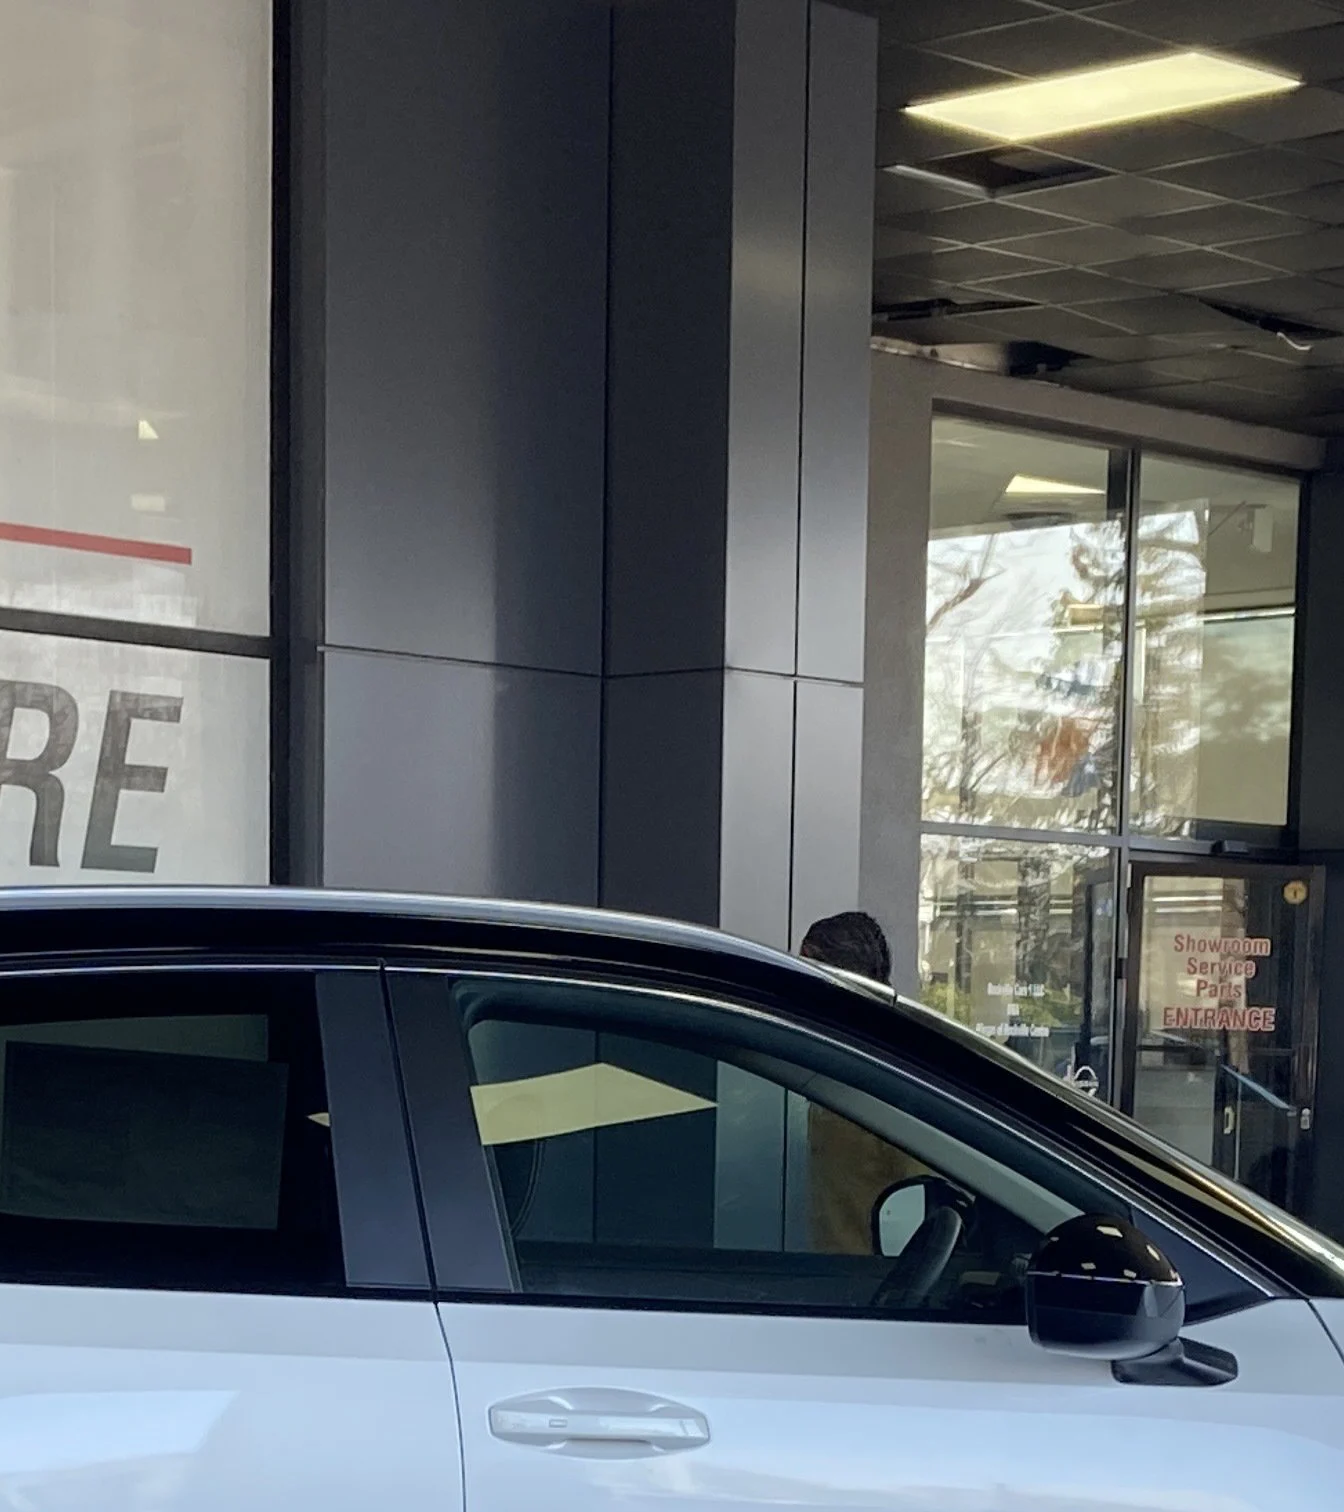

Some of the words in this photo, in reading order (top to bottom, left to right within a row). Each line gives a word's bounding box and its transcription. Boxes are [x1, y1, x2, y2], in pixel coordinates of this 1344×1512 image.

[1174, 934, 1270, 955] Showroom
[1186, 957, 1256, 977] Service
[1195, 979, 1242, 998] Parts
[1162, 1006, 1275, 1031] ENTRANCE
